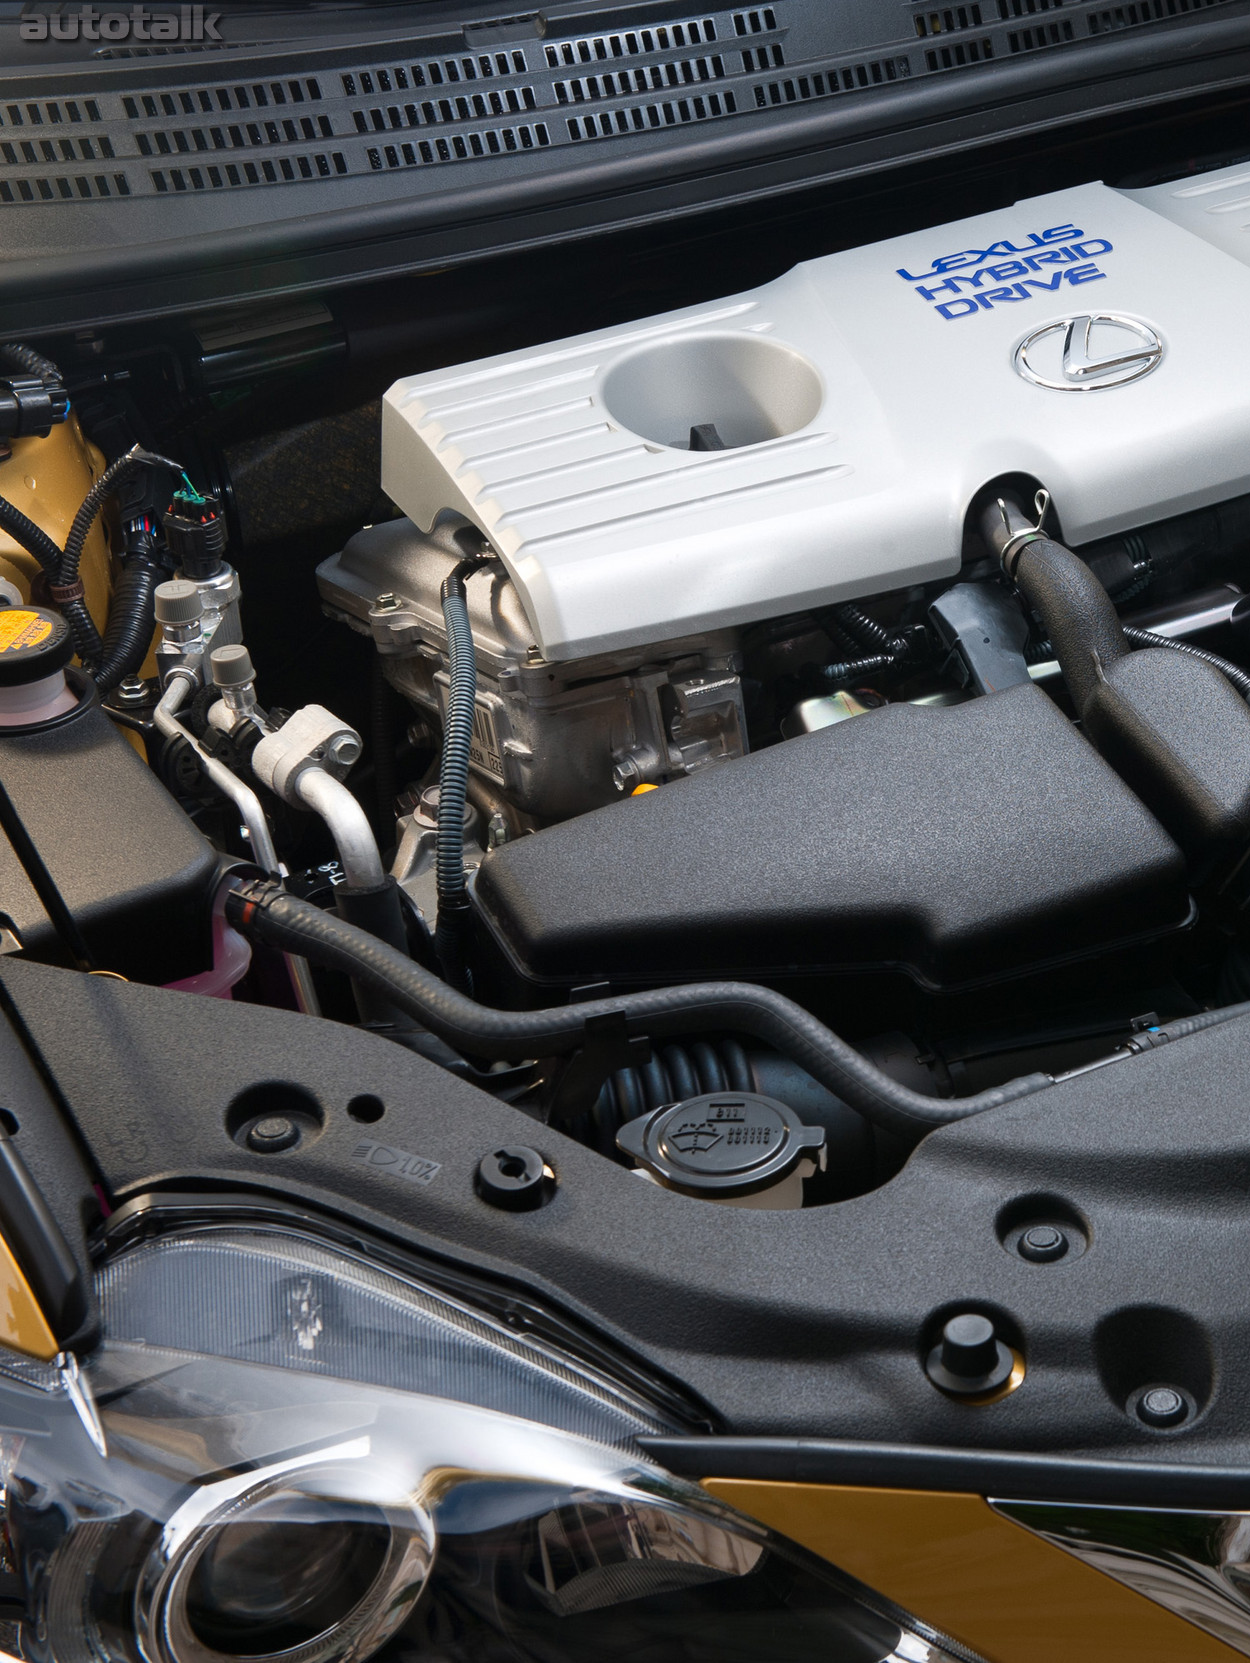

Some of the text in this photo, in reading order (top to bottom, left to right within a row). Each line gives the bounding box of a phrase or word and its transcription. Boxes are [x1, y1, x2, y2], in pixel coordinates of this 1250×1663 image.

[896, 223, 1084, 281] LEXUS
[915, 238, 1113, 300] HYBRID
[934, 262, 1107, 320] DRIVE
